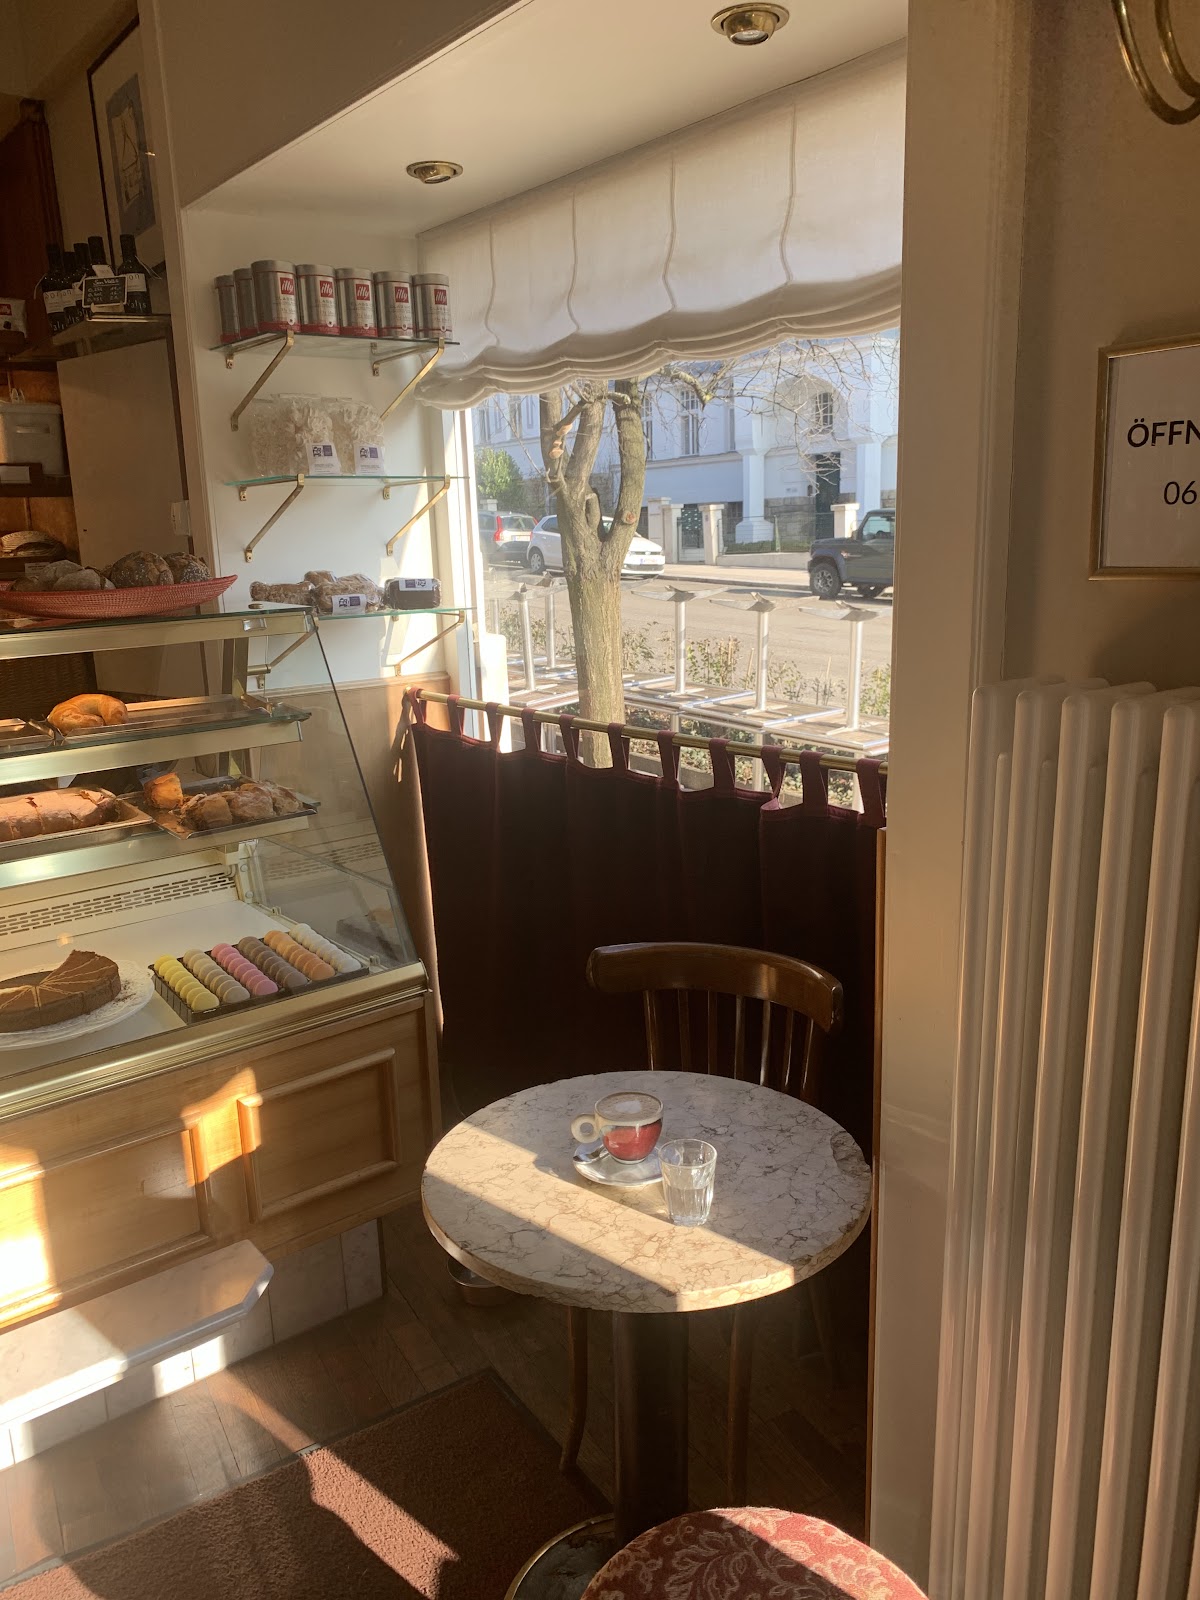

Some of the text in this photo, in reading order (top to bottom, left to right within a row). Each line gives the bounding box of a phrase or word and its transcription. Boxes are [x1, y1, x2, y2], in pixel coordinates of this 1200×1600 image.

[281, 280, 294, 294] illy
[321, 283, 333, 297] illy
[357, 286, 370, 299] illy
[396, 289, 408, 302] illy
[435, 291, 447, 305] illy
